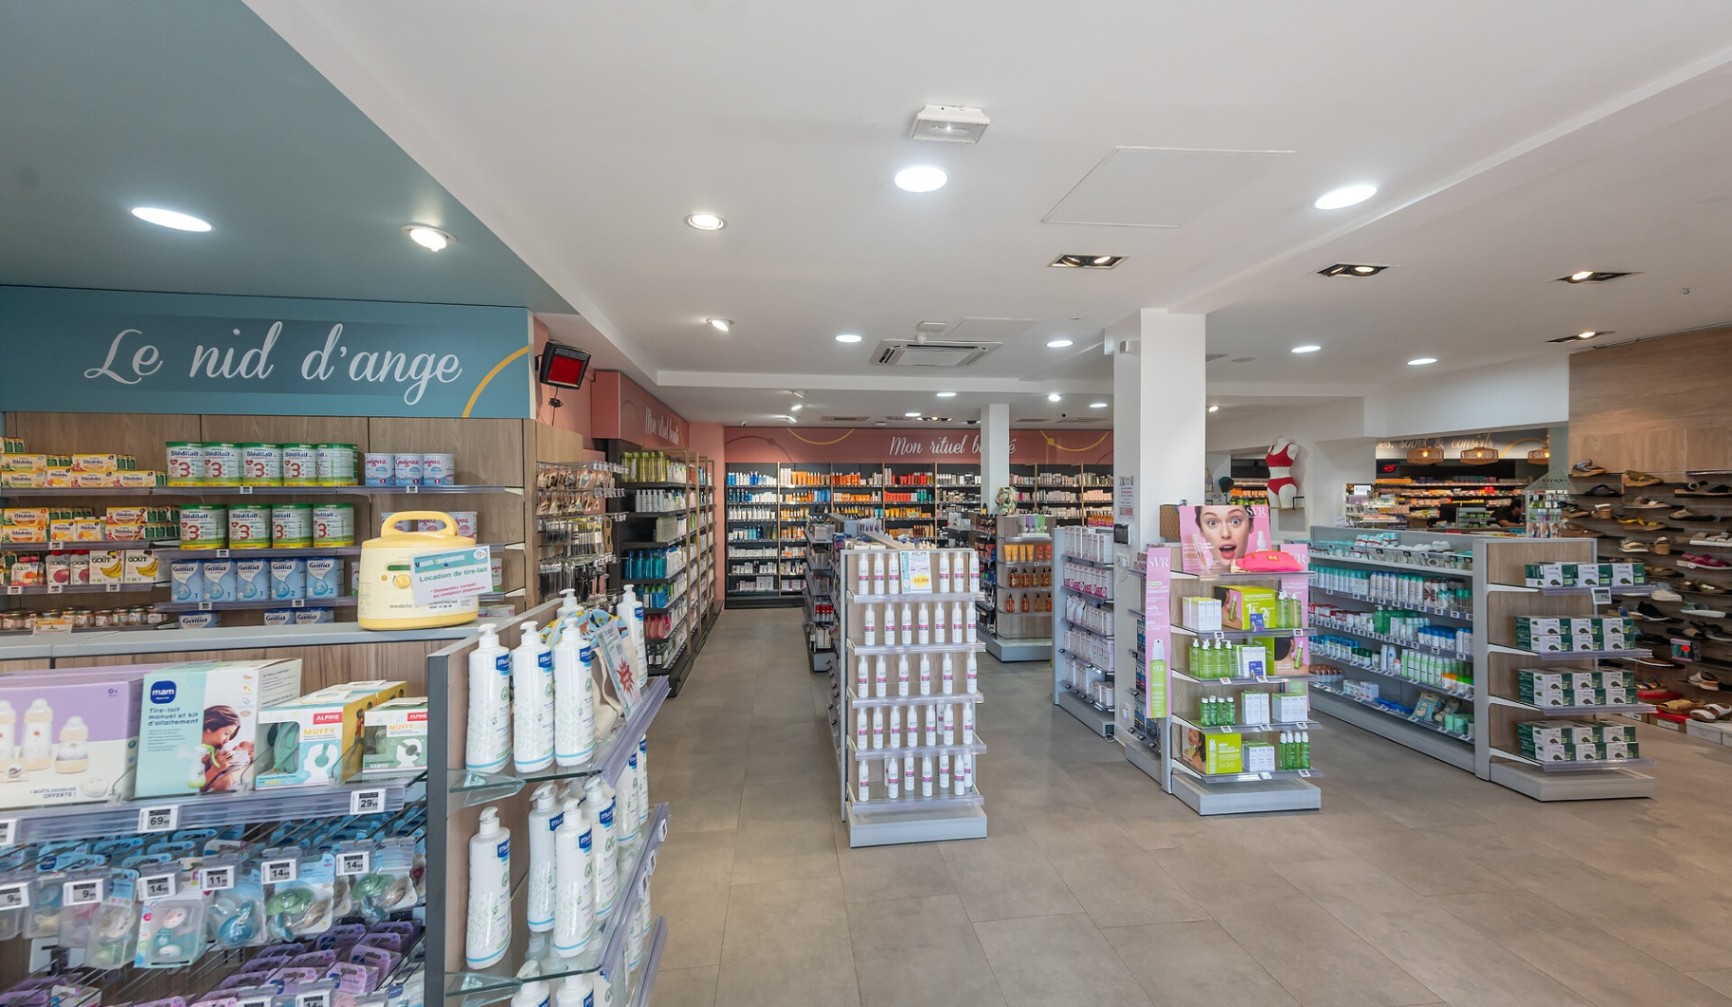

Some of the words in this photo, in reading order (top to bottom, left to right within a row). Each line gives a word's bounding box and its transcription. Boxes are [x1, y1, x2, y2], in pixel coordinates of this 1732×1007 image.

[84, 329, 163, 385] Le
[190, 321, 283, 379] nid
[301, 323, 463, 405] d'ange
[889, 436, 923, 456] Mon
[930, 434, 968, 454] rituel
[178, 462, 191, 477] 3
[211, 462, 222, 477] 3
[254, 462, 265, 478] 3
[291, 463, 301, 478] 3
[1246, 508, 1265, 516] SVR
[188, 524, 200, 541] 3
[239, 524, 250, 540] 3
[275, 524, 284, 539] 3
[318, 523, 327, 538] 3
[1148, 557, 1169, 568] SVR
[419, 573, 452, 582] Location
[464, 567, 488, 575] tire-lait
[152, 688, 175, 696] mam
[148, 718, 198, 727] d'allaitement
[304, 728, 336, 736] MUFFY
[361, 800, 372, 808] 29
[150, 817, 164, 825] 69
[347, 861, 357, 869] 14
[272, 869, 283, 877] 14
[83, 890, 89, 898] 9
[150, 884, 162, 892] 14
